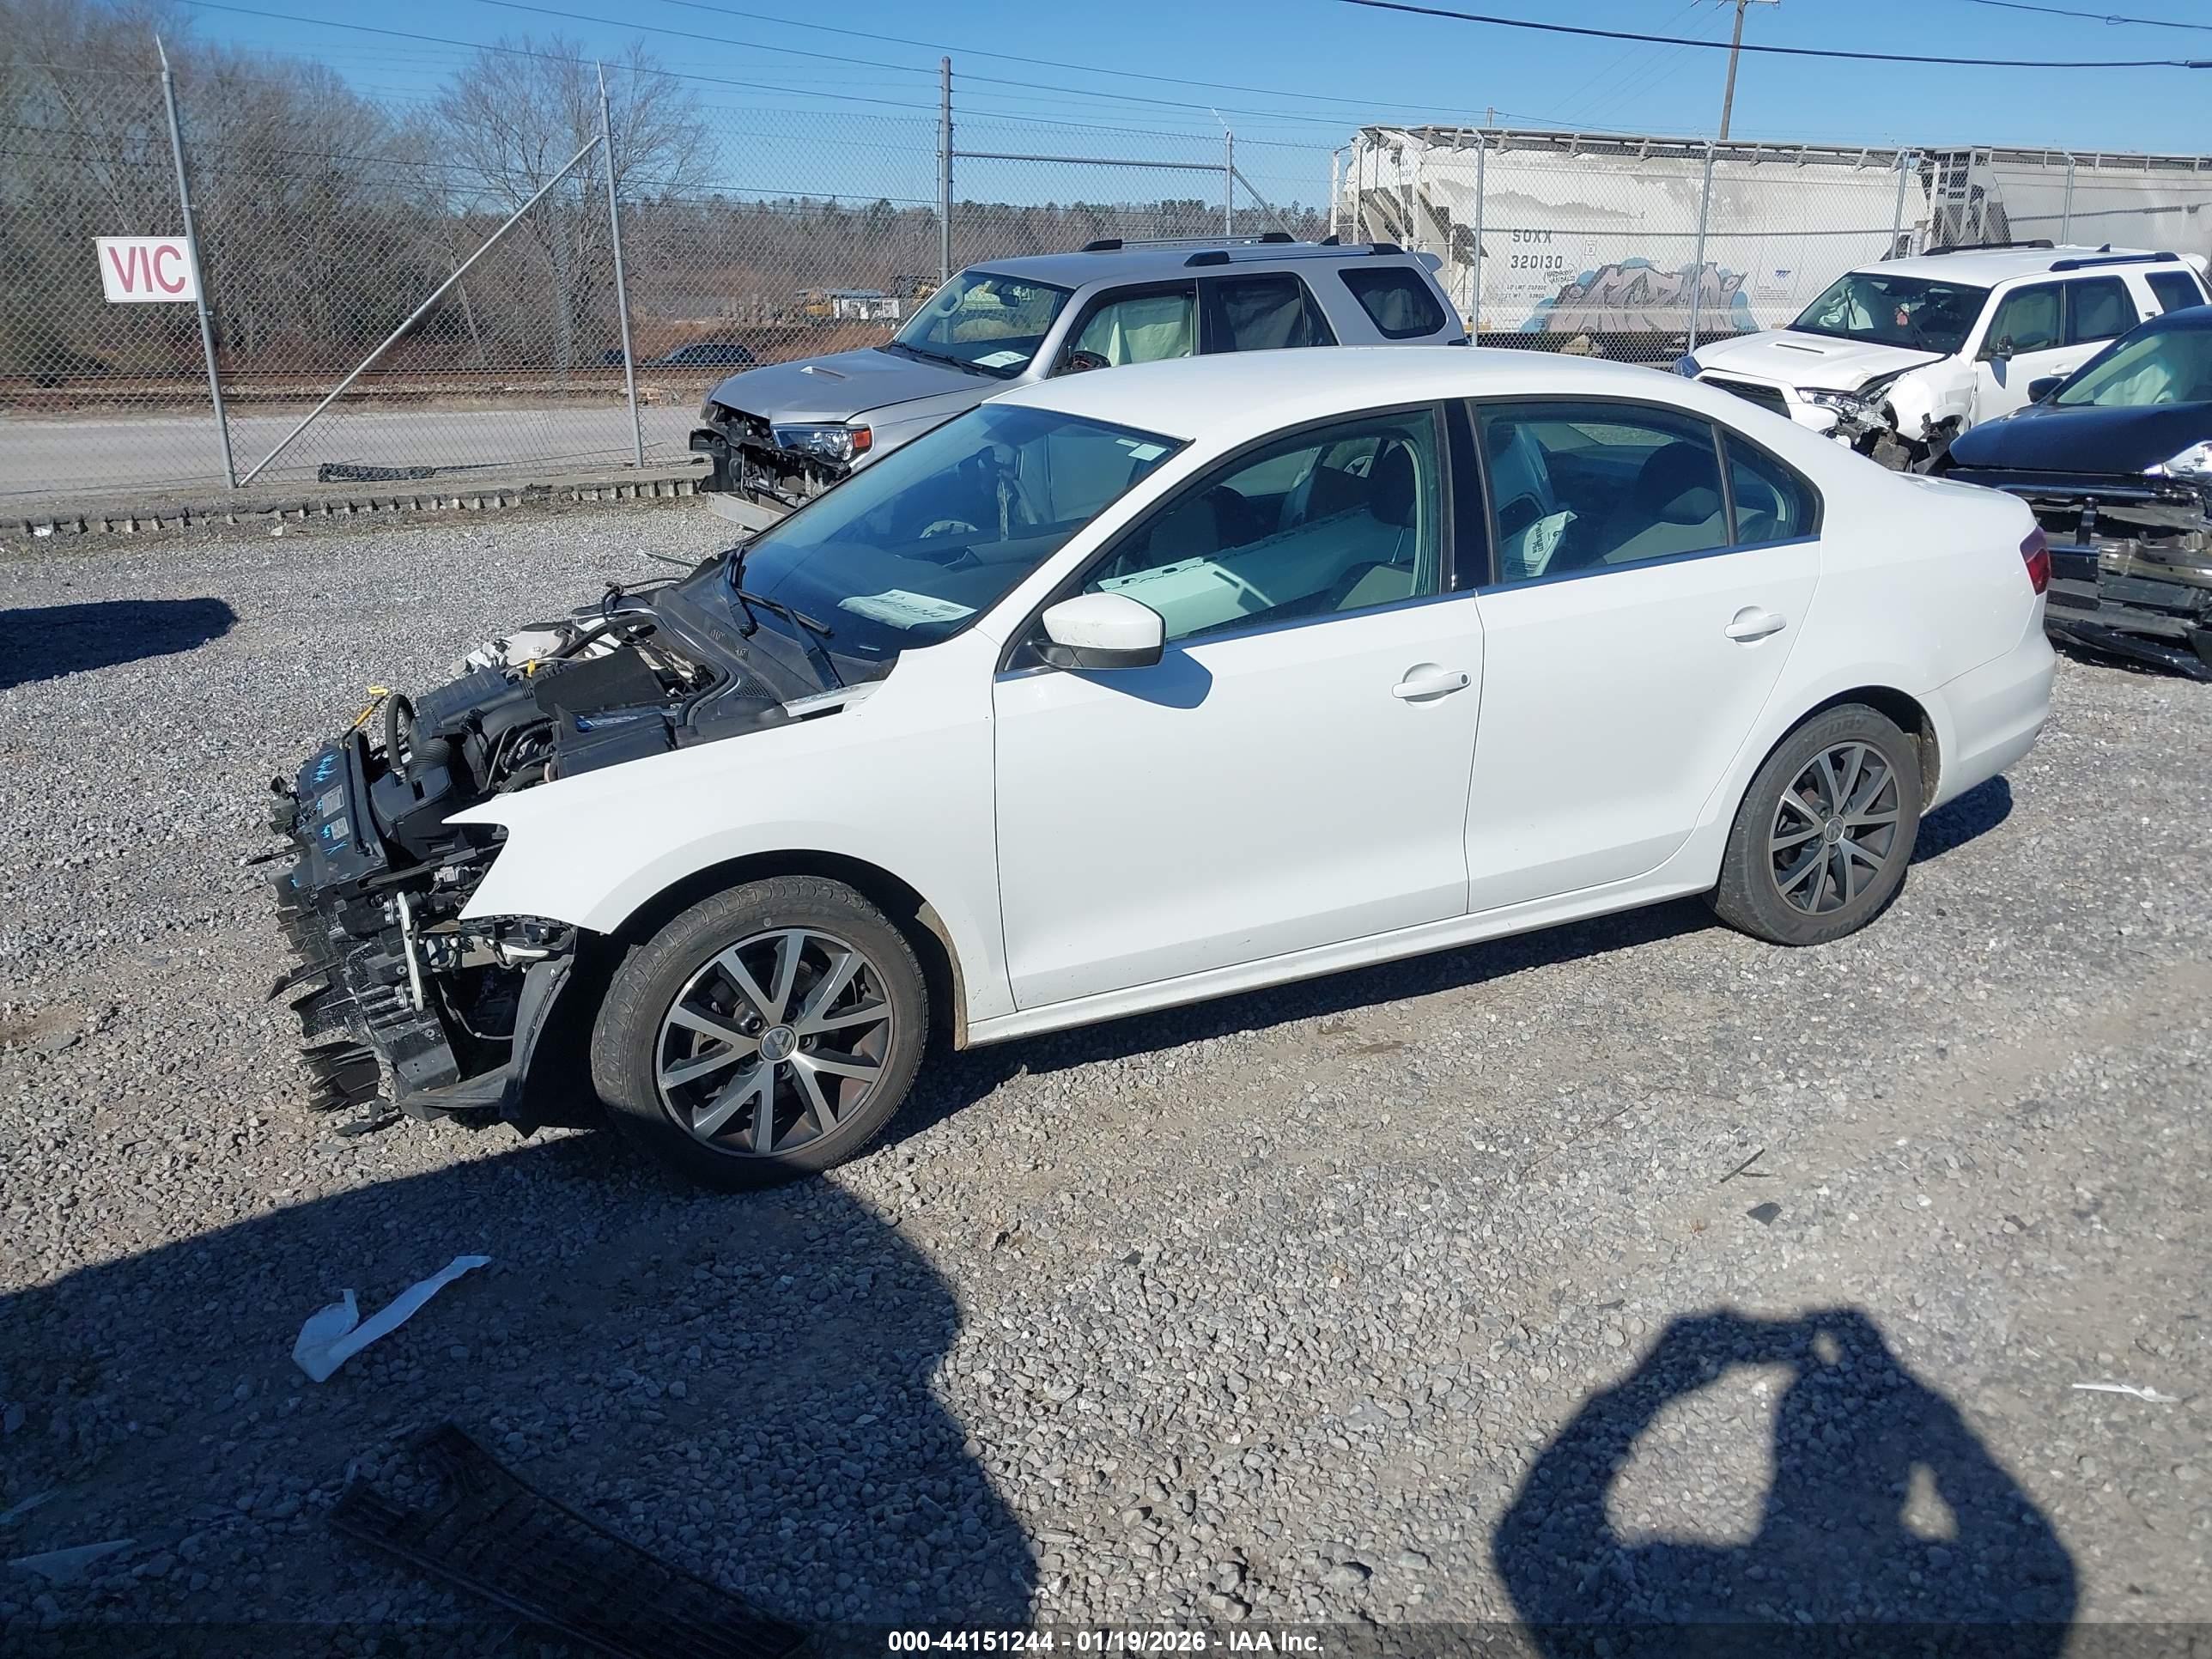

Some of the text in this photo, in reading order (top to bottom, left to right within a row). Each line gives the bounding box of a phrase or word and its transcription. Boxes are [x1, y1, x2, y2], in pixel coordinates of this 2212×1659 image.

[1512, 229, 1553, 243] SOXX
[1510, 255, 1563, 269] 320130
[107, 245, 186, 294] VIC
